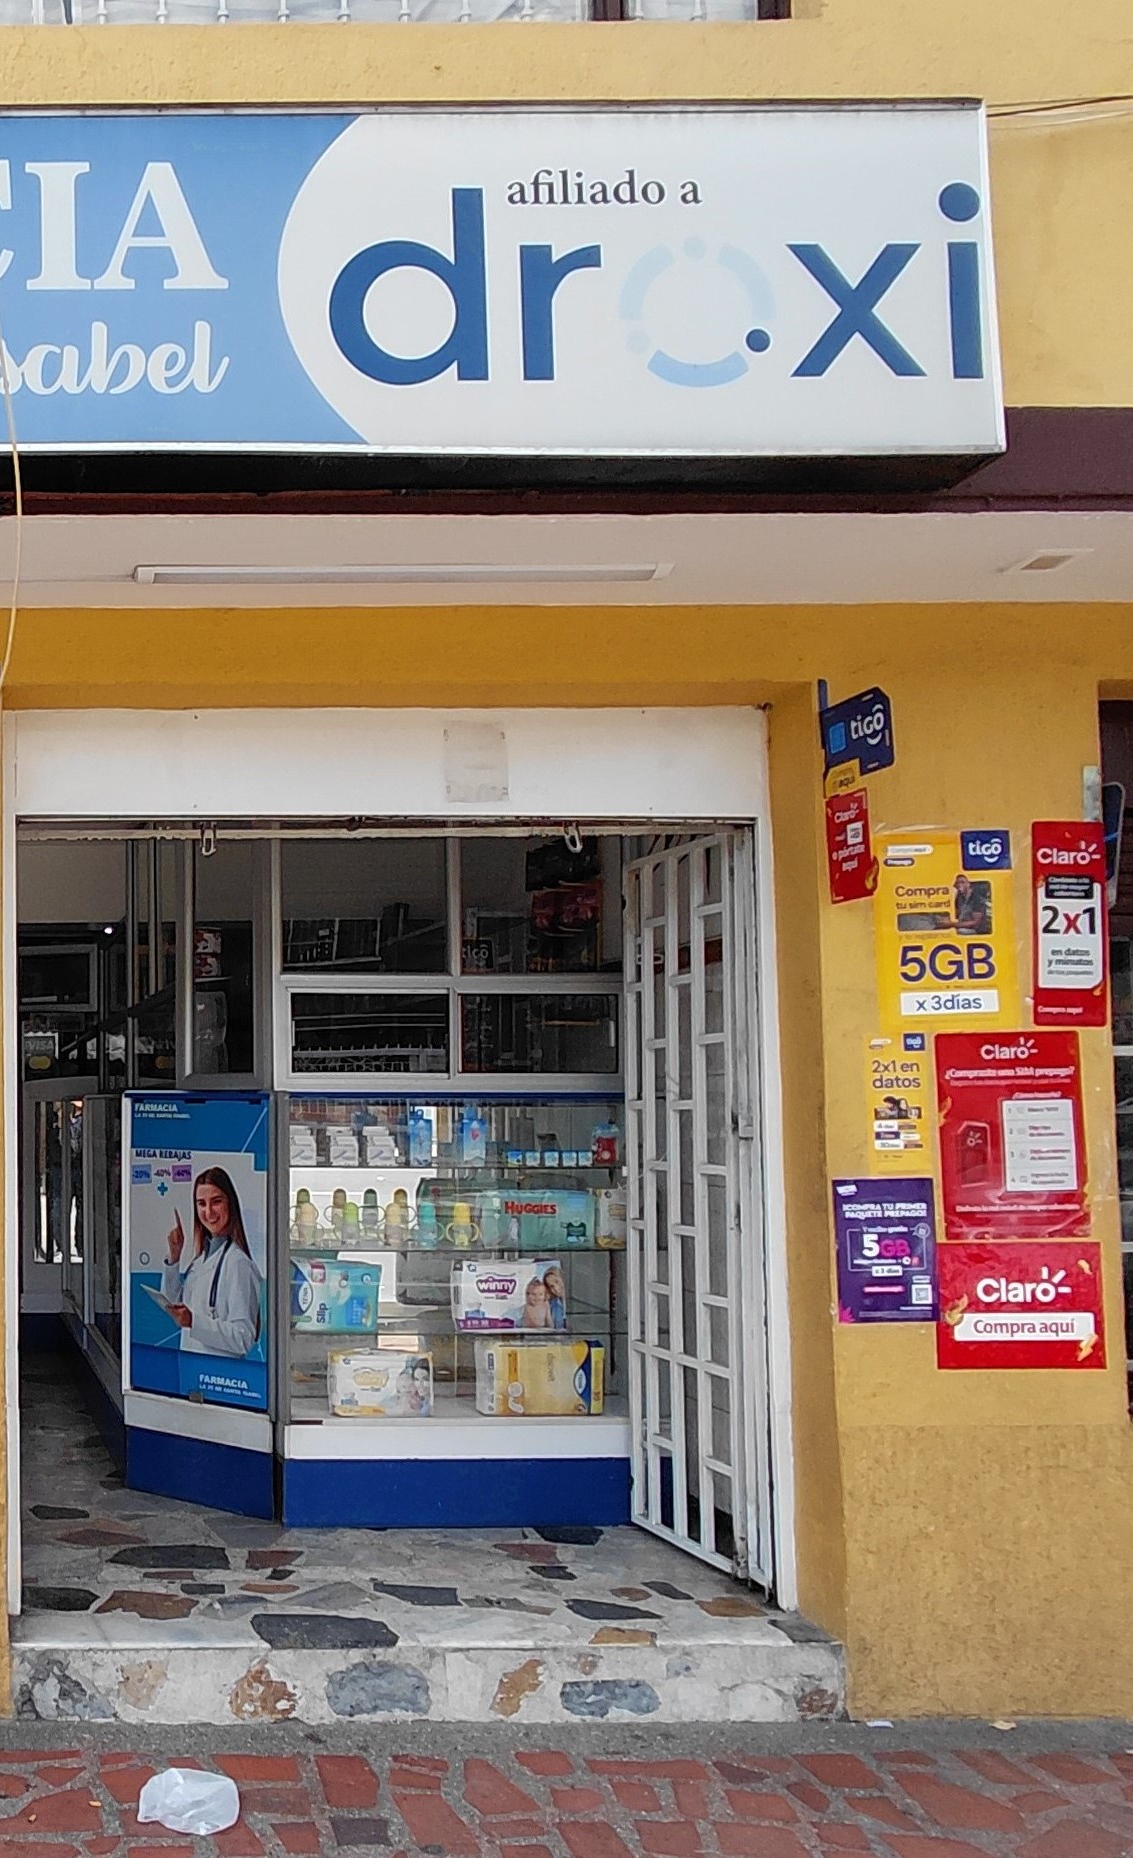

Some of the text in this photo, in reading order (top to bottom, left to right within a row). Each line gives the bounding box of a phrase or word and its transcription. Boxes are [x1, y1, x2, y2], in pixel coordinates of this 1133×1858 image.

[506, 168, 702, 206] afiliado a
[327, 181, 986, 388] droxi
[968, 839, 1003, 858] tigo
[1036, 846, 1092, 865] Claro
[895, 886, 950, 898] Compra
[896, 902, 907, 910] tu
[1042, 905, 1096, 934] 2x1
[899, 943, 996, 982] 5GB
[980, 1043, 1030, 1060] Claro
[871, 1060, 920, 1073] 2x1 en
[872, 1075, 921, 1089] datos
[134, 1103, 178, 1113] FARMACIA
[135, 1149, 192, 1162] MEGA REBAJAS
[504, 1201, 557, 1215] HUGGIES
[477, 1277, 515, 1294] winny
[976, 1275, 1058, 1303] Claro
[973, 1317, 1076, 1337] Compra aquí
[199, 1374, 248, 1389] FARMACIA
